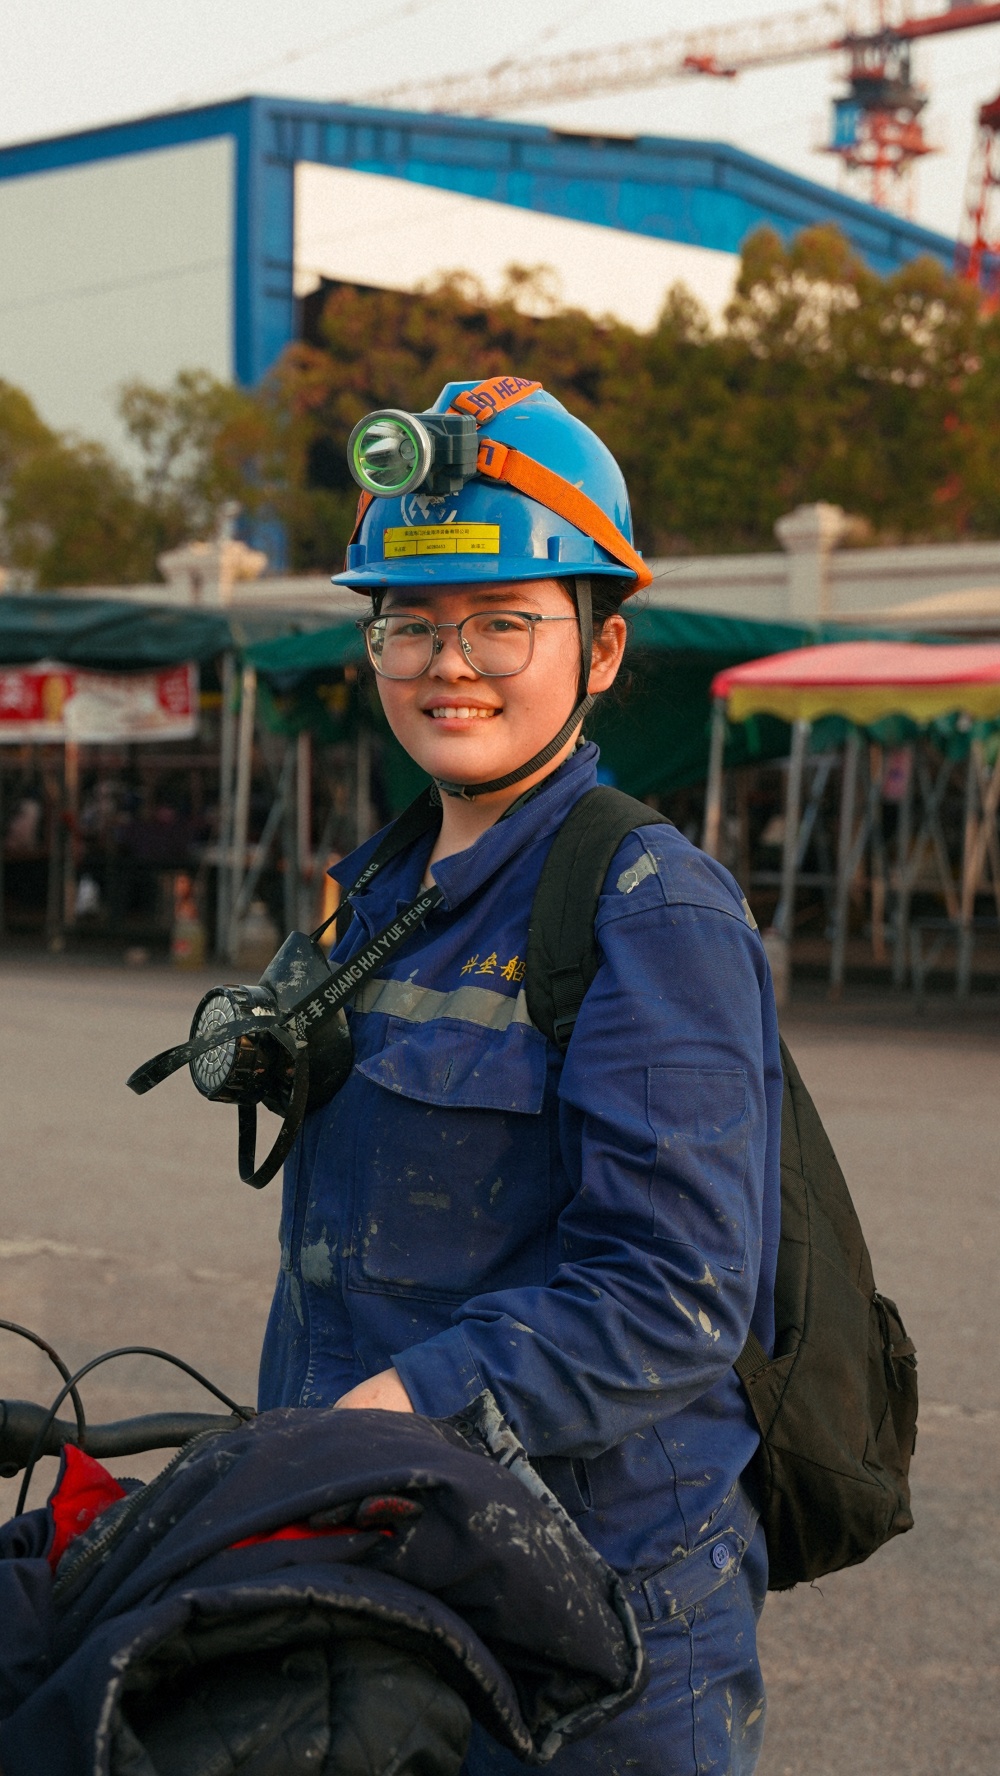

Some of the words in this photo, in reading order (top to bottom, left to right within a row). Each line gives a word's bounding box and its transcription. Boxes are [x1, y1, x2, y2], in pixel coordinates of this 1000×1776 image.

[355, 862, 379, 888] FENG
[378, 923, 406, 948] YUE
[402, 897, 432, 927] FENG
